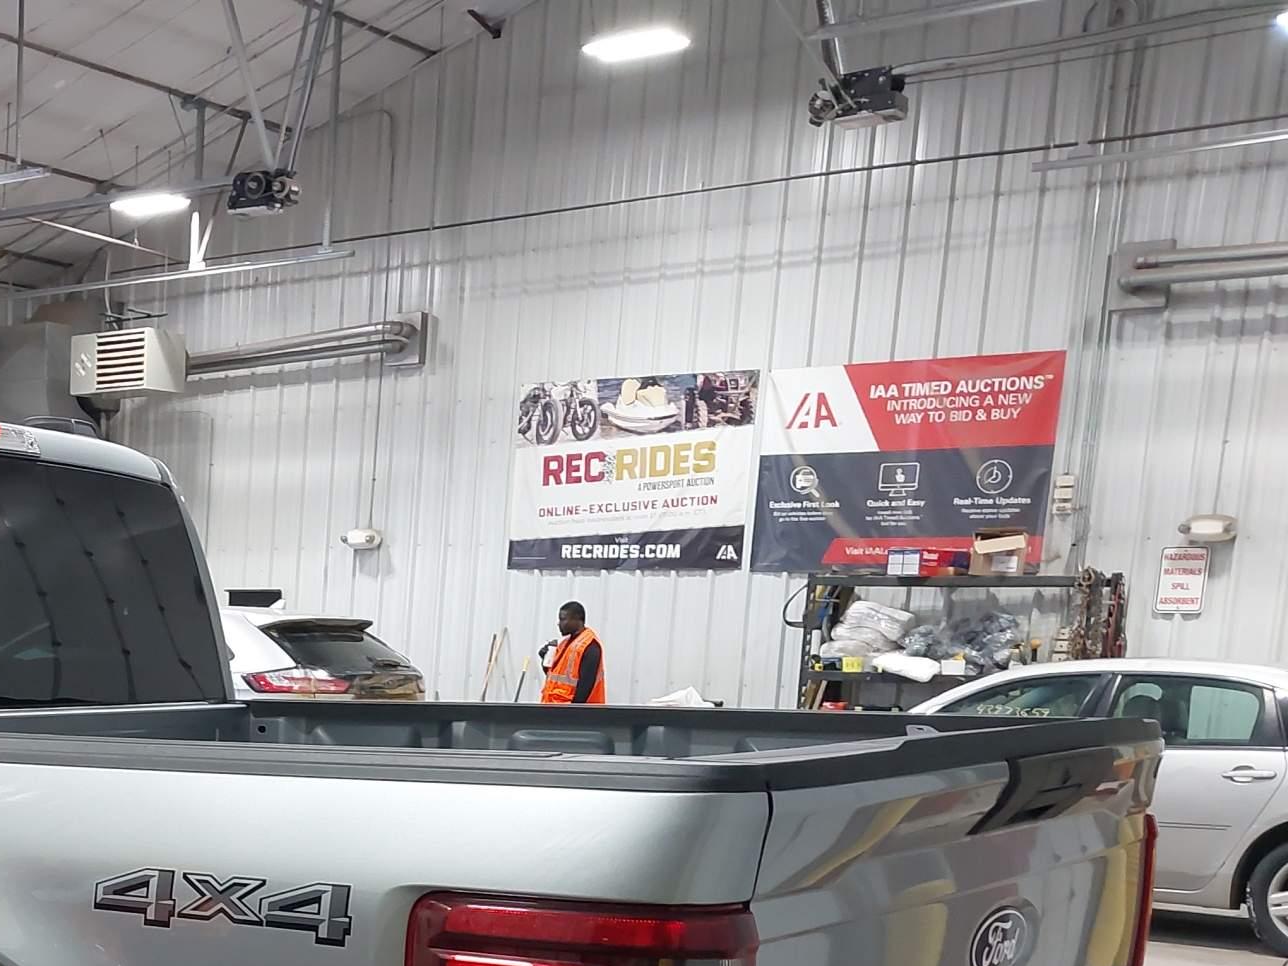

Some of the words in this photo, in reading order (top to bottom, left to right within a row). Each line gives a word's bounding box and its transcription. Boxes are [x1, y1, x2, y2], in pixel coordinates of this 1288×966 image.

[870, 384, 899, 399] IAA
[902, 381, 952, 397] TIMED
[886, 396, 980, 412] INTRODUCING
[983, 395, 995, 407] A
[997, 393, 1032, 406] NEW
[894, 412, 925, 425] WAY
[927, 411, 946, 423] TO
[949, 409, 973, 422] BID
[975, 408, 987, 421] &
[990, 407, 1022, 420] BUY
[538, 500, 659, 518] ONLINE-EXCLUSIVE
[661, 495, 719, 510] AUCTION
[561, 544, 681, 560] RECRIDES.COM
[1171, 582, 1190, 591] SPILL
